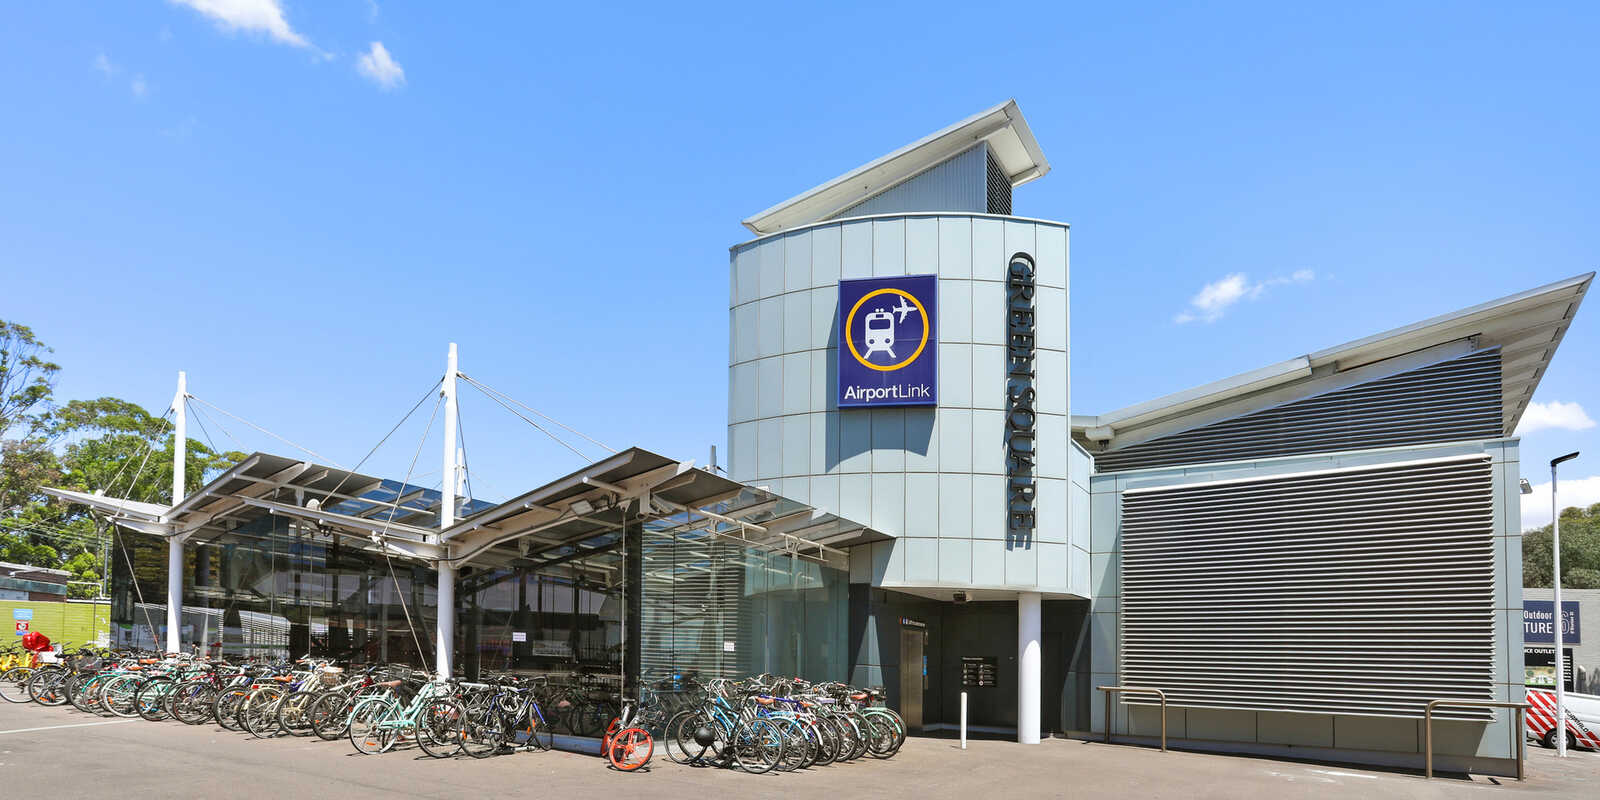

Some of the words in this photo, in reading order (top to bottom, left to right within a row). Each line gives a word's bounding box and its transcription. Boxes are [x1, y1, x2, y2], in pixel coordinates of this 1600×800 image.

[844, 383, 930, 402] AirportLink
[1006, 386, 1036, 530] SQUARE
[1523, 610, 1553, 620] Outdoor
